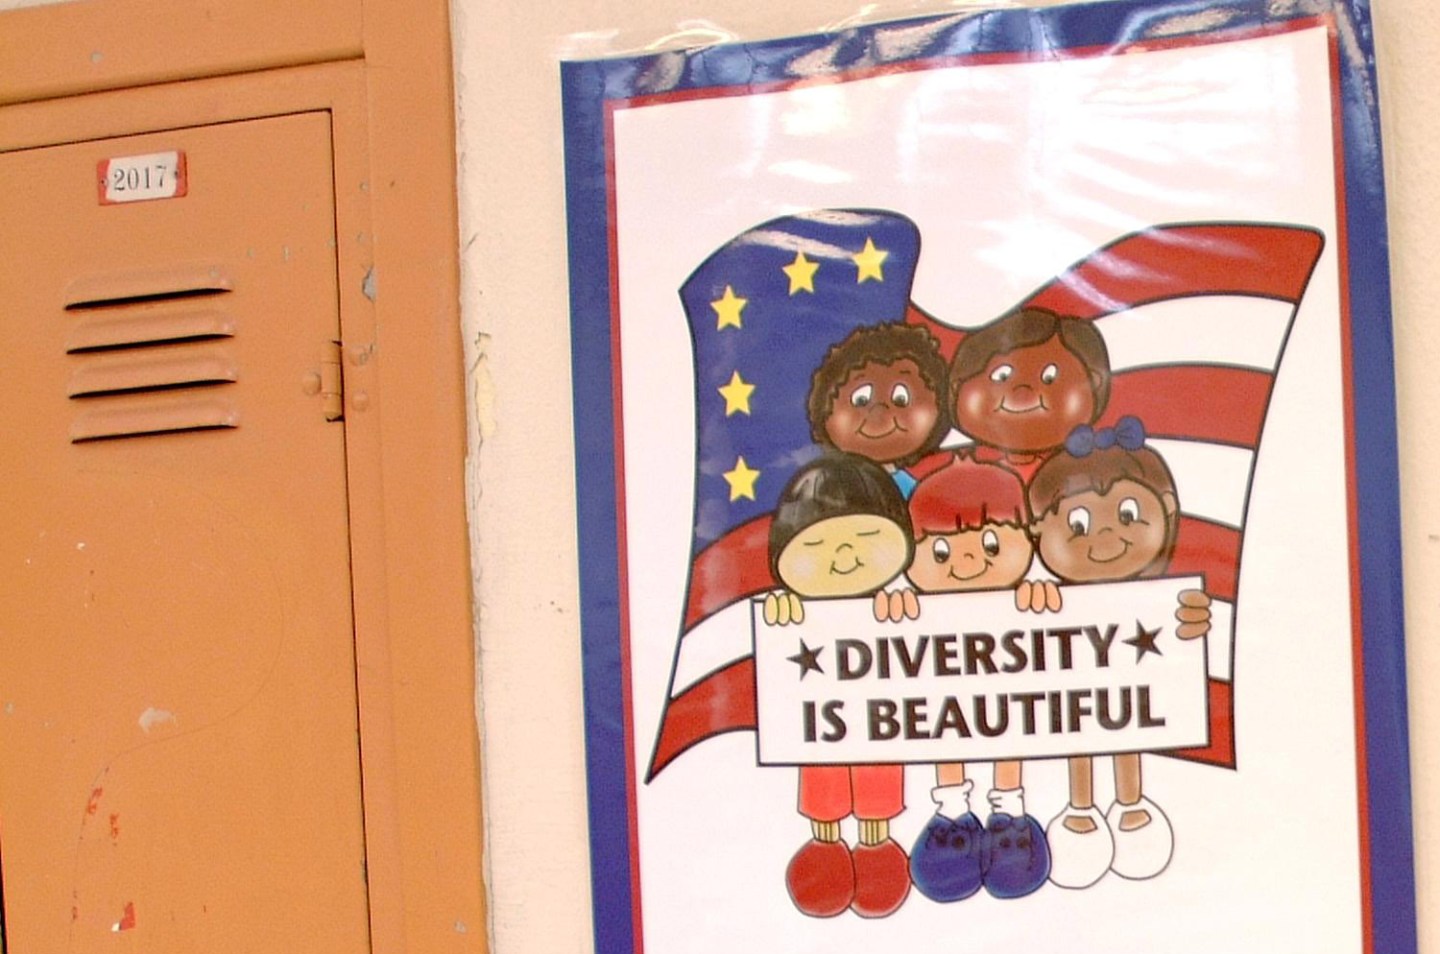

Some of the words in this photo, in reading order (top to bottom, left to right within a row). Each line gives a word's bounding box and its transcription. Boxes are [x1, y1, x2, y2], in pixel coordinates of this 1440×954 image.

[113, 164, 166, 191] 2017
[835, 623, 1119, 681] DIVERSITY
[802, 699, 847, 742] IS
[866, 685, 1166, 741] BEAUTIFUL
